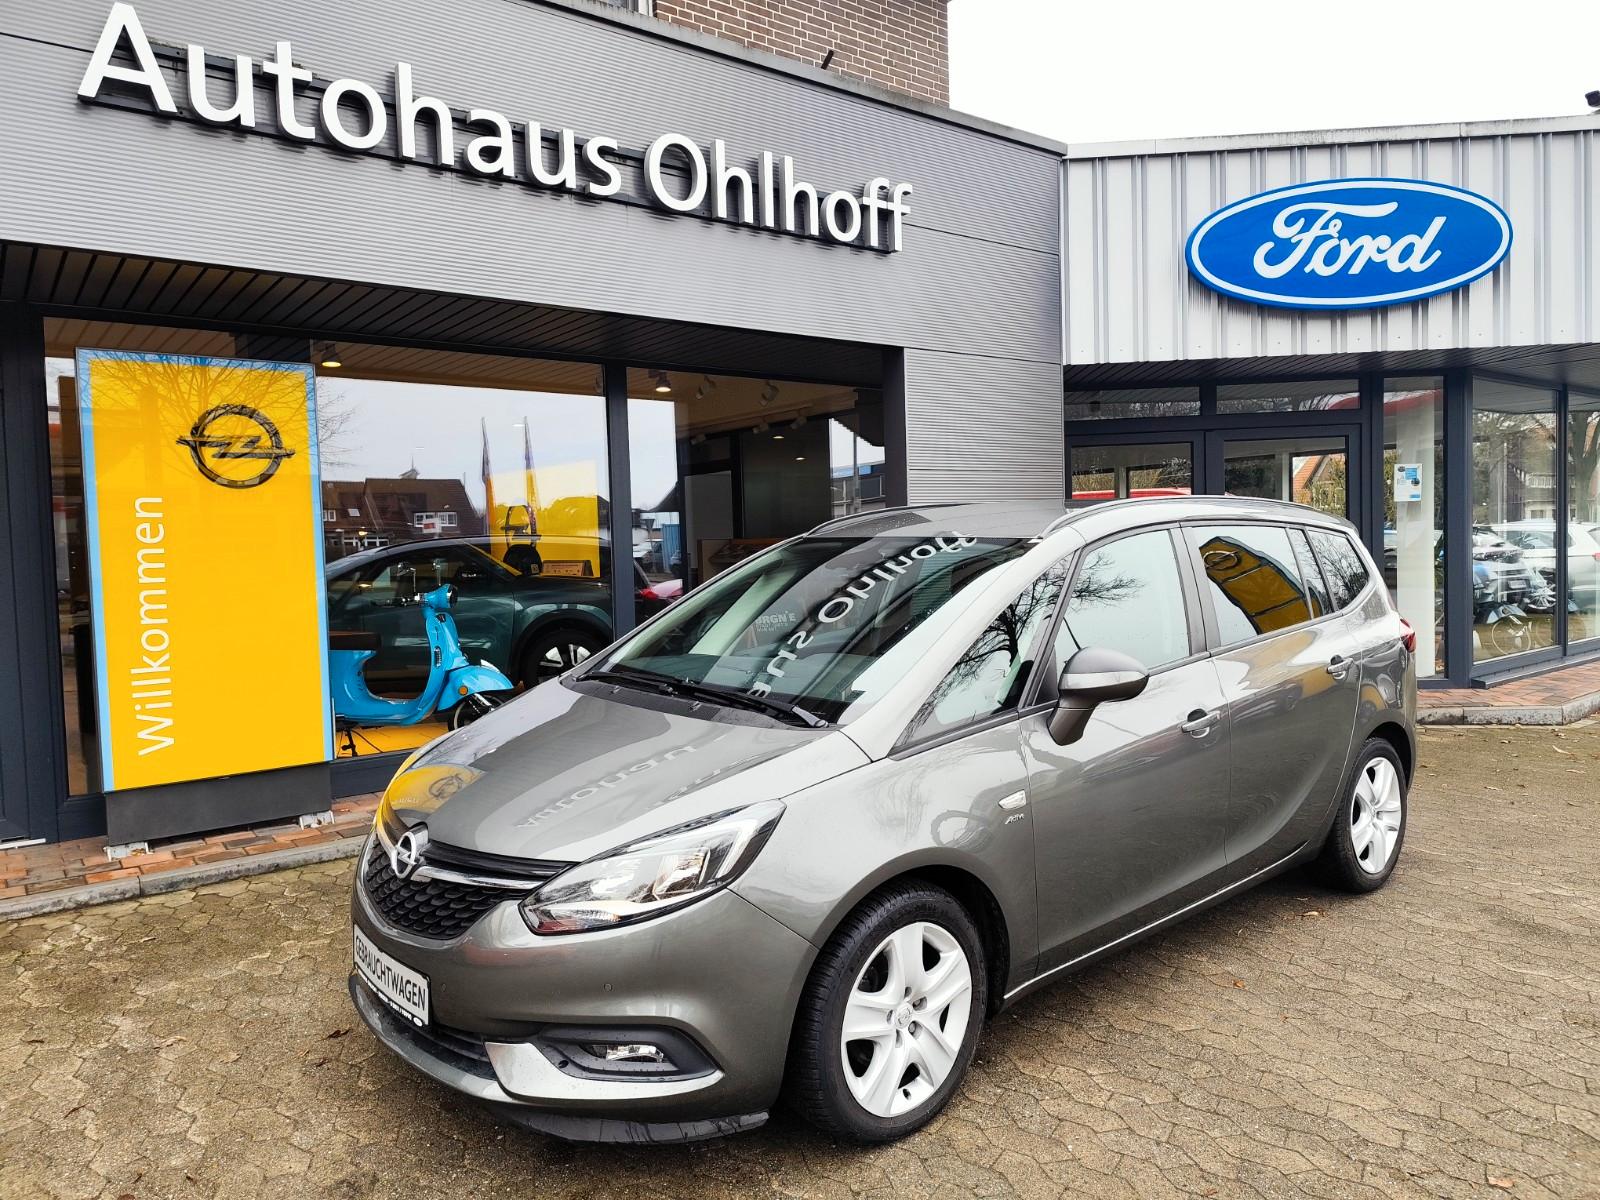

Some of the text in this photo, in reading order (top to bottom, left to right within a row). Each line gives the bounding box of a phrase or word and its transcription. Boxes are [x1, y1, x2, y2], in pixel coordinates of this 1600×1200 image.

[77, 1, 913, 252] Autohaus Ohlhoff
[1253, 201, 1447, 279] Ford
[130, 497, 175, 756] Willkommen
[355, 935, 426, 1012] GEBRAUCHTWAGEN
